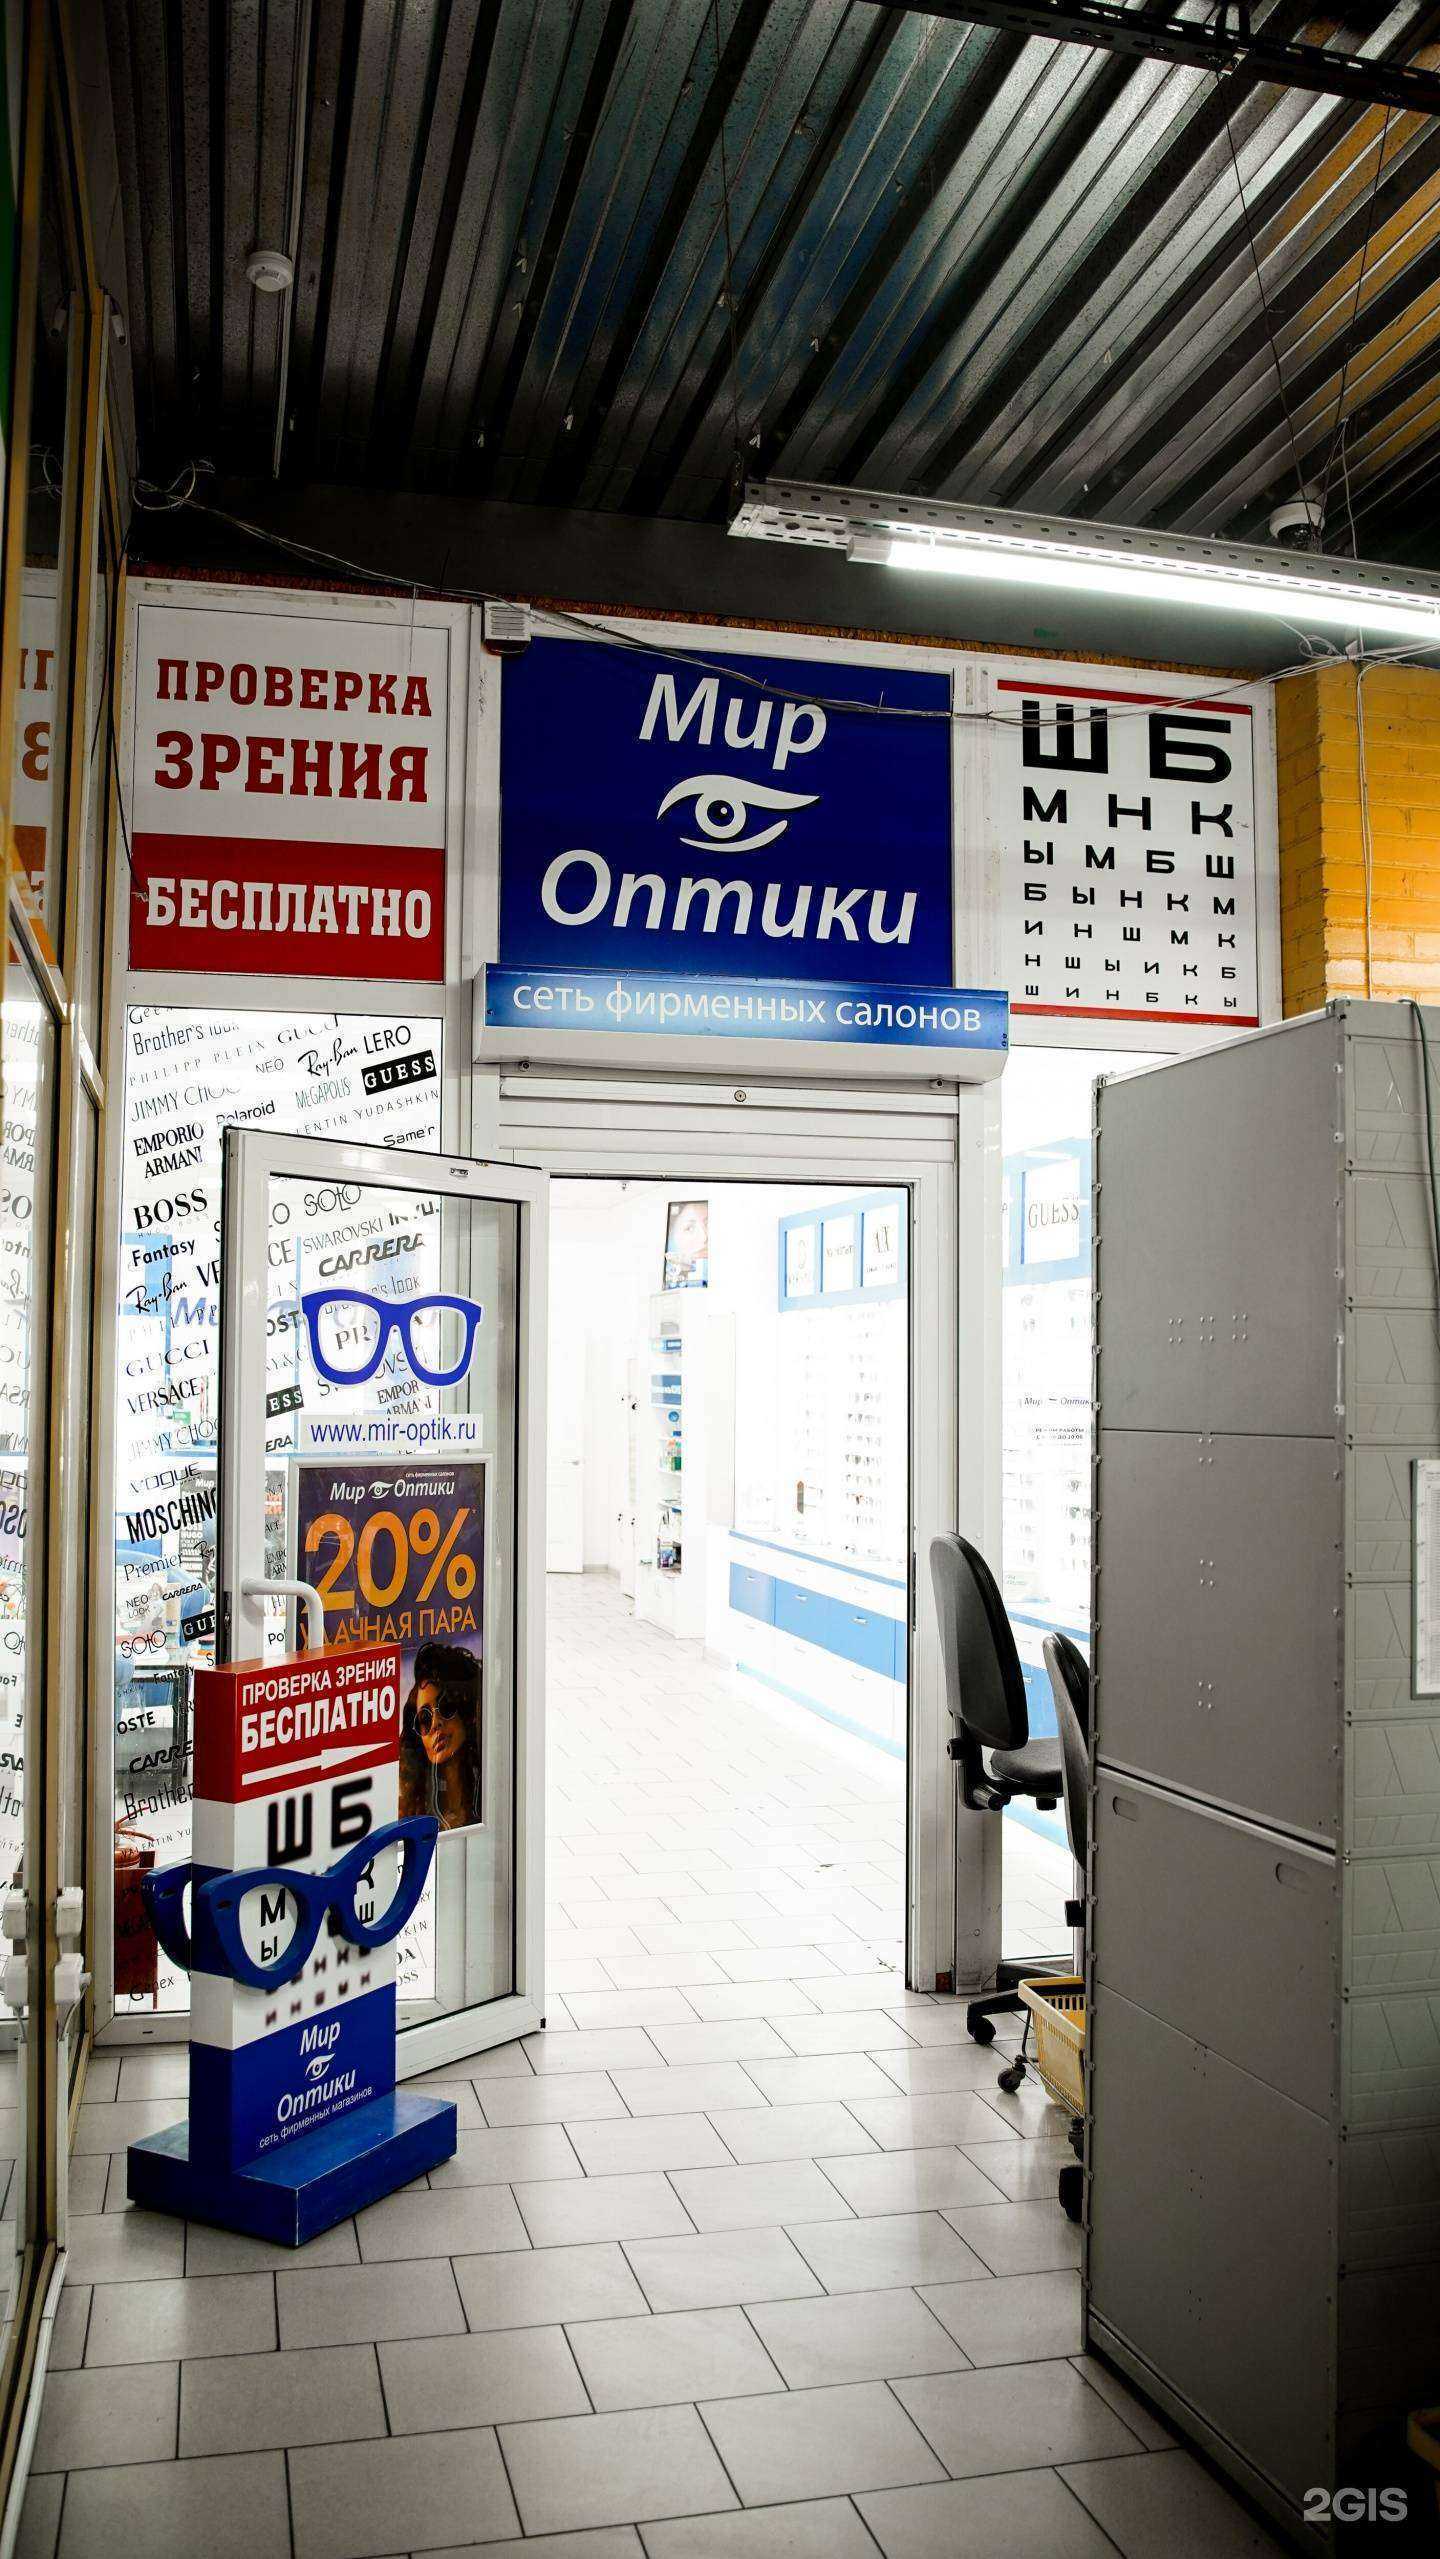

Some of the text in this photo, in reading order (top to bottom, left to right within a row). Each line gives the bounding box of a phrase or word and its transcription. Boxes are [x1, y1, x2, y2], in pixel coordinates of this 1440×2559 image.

[156, 658, 432, 717] ПРОВЕРКА
[638, 673, 827, 770] Мир
[155, 731, 429, 802] ЗРЕНИЯ
[146, 878, 431, 939] БЕСПЛАТНО
[540, 849, 917, 944] Оптики
[512, 981, 981, 1032] сеть фирменных салонов
[364, 1025, 411, 1054] LERO
[255, 1058, 284, 1074] NEO
[364, 1056, 435, 1089] GUESS
[131, 1090, 178, 1122] JIMMY
[295, 1077, 352, 1110] MEGAPOLIS
[353, 1089, 439, 1120] YUDASHKIN
[133, 1121, 204, 1157] EMPORIO
[143, 1145, 204, 1179] ARMANI
[134, 1188, 208, 1230] BOSS
[1028, 1203, 1079, 1228] GUESS
[303, 1217, 383, 1254] SWAROVSKI
[132, 1240, 195, 1267] Fantasy
[319, 1233, 426, 1277] CARRERA
[126, 1339, 209, 1376] GUCCI
[127, 1378, 201, 1414] VERSACE
[310, 1417, 476, 1446] www.mir-optik.ru
[330, 1478, 455, 1504] Мир Оптики
[124, 1551, 183, 1581] Premier
[126, 1594, 149, 1609] NEO
[162, 1583, 203, 1601] CARRERA
[419, 1606, 477, 1638] ПАРА
[154, 1665, 194, 1684] Fantasy
[241, 1657, 396, 1706] ПРОВЕРКА ЗРЕНИЯ
[117, 1711, 155, 1735] OSTE
[241, 1685, 396, 1753] БЕСПЛАТНО
[129, 1740, 193, 1773] CARRE
[267, 1775, 373, 1866] Ш Б
[260, 1888, 286, 1928] М
[260, 1936, 278, 1963] Ы
[299, 2022, 341, 2055] Мир
[277, 2069, 356, 2122] Оптики
[259, 2086, 372, 2148] сеть фирменных магазинов
